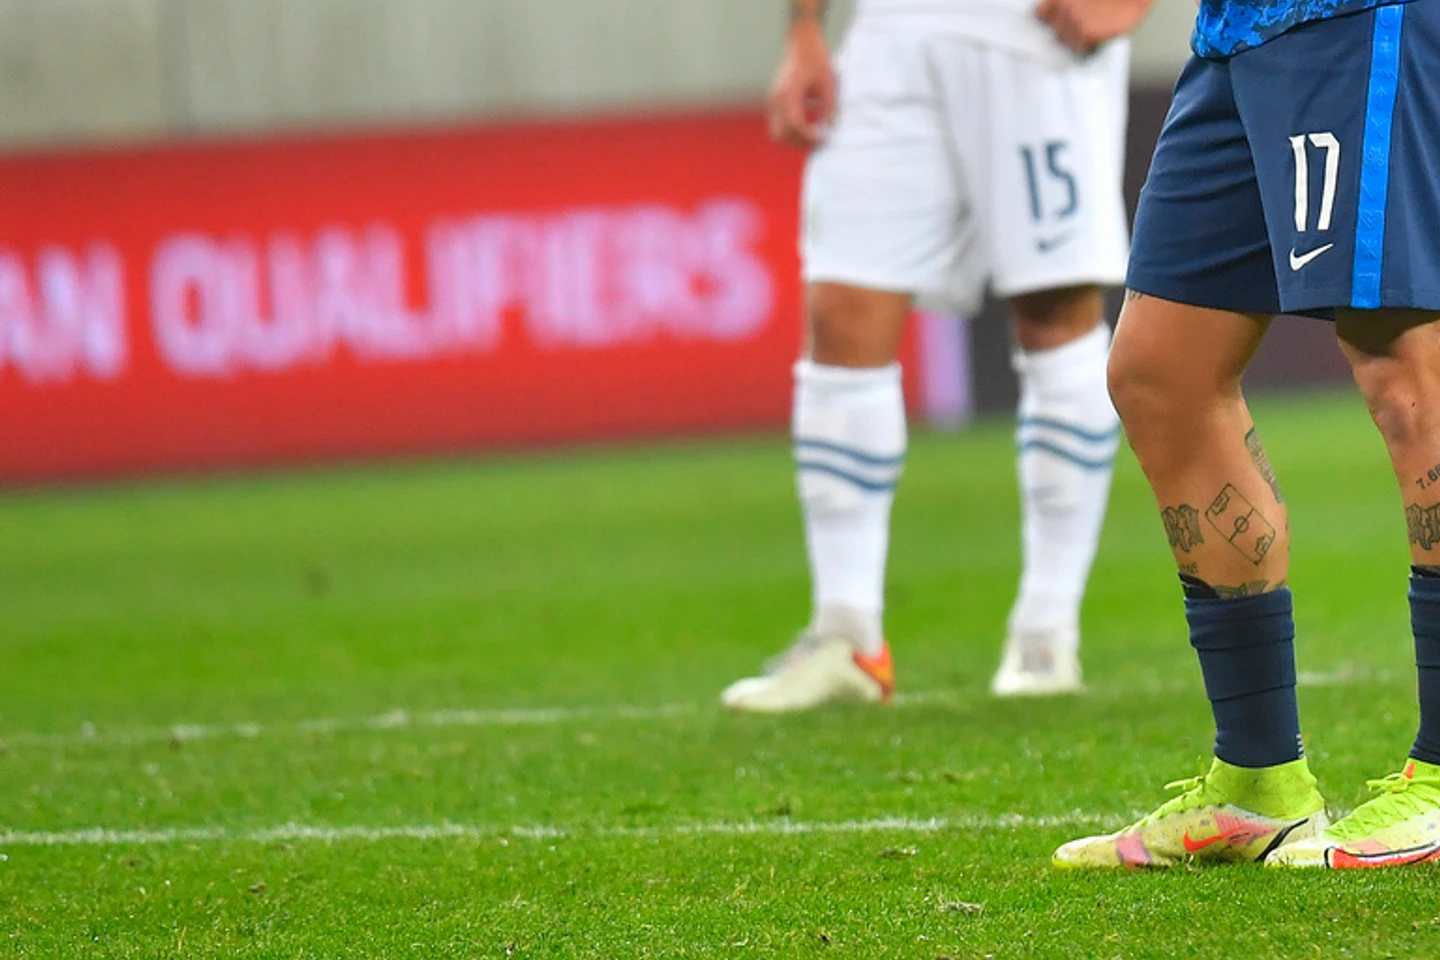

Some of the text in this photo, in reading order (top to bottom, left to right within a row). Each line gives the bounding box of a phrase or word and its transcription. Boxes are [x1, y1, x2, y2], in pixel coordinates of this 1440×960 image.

[1018, 138, 1078, 222] 15
[1289, 132, 1340, 232] 17
[151, 197, 774, 378] QUALIFIERS
